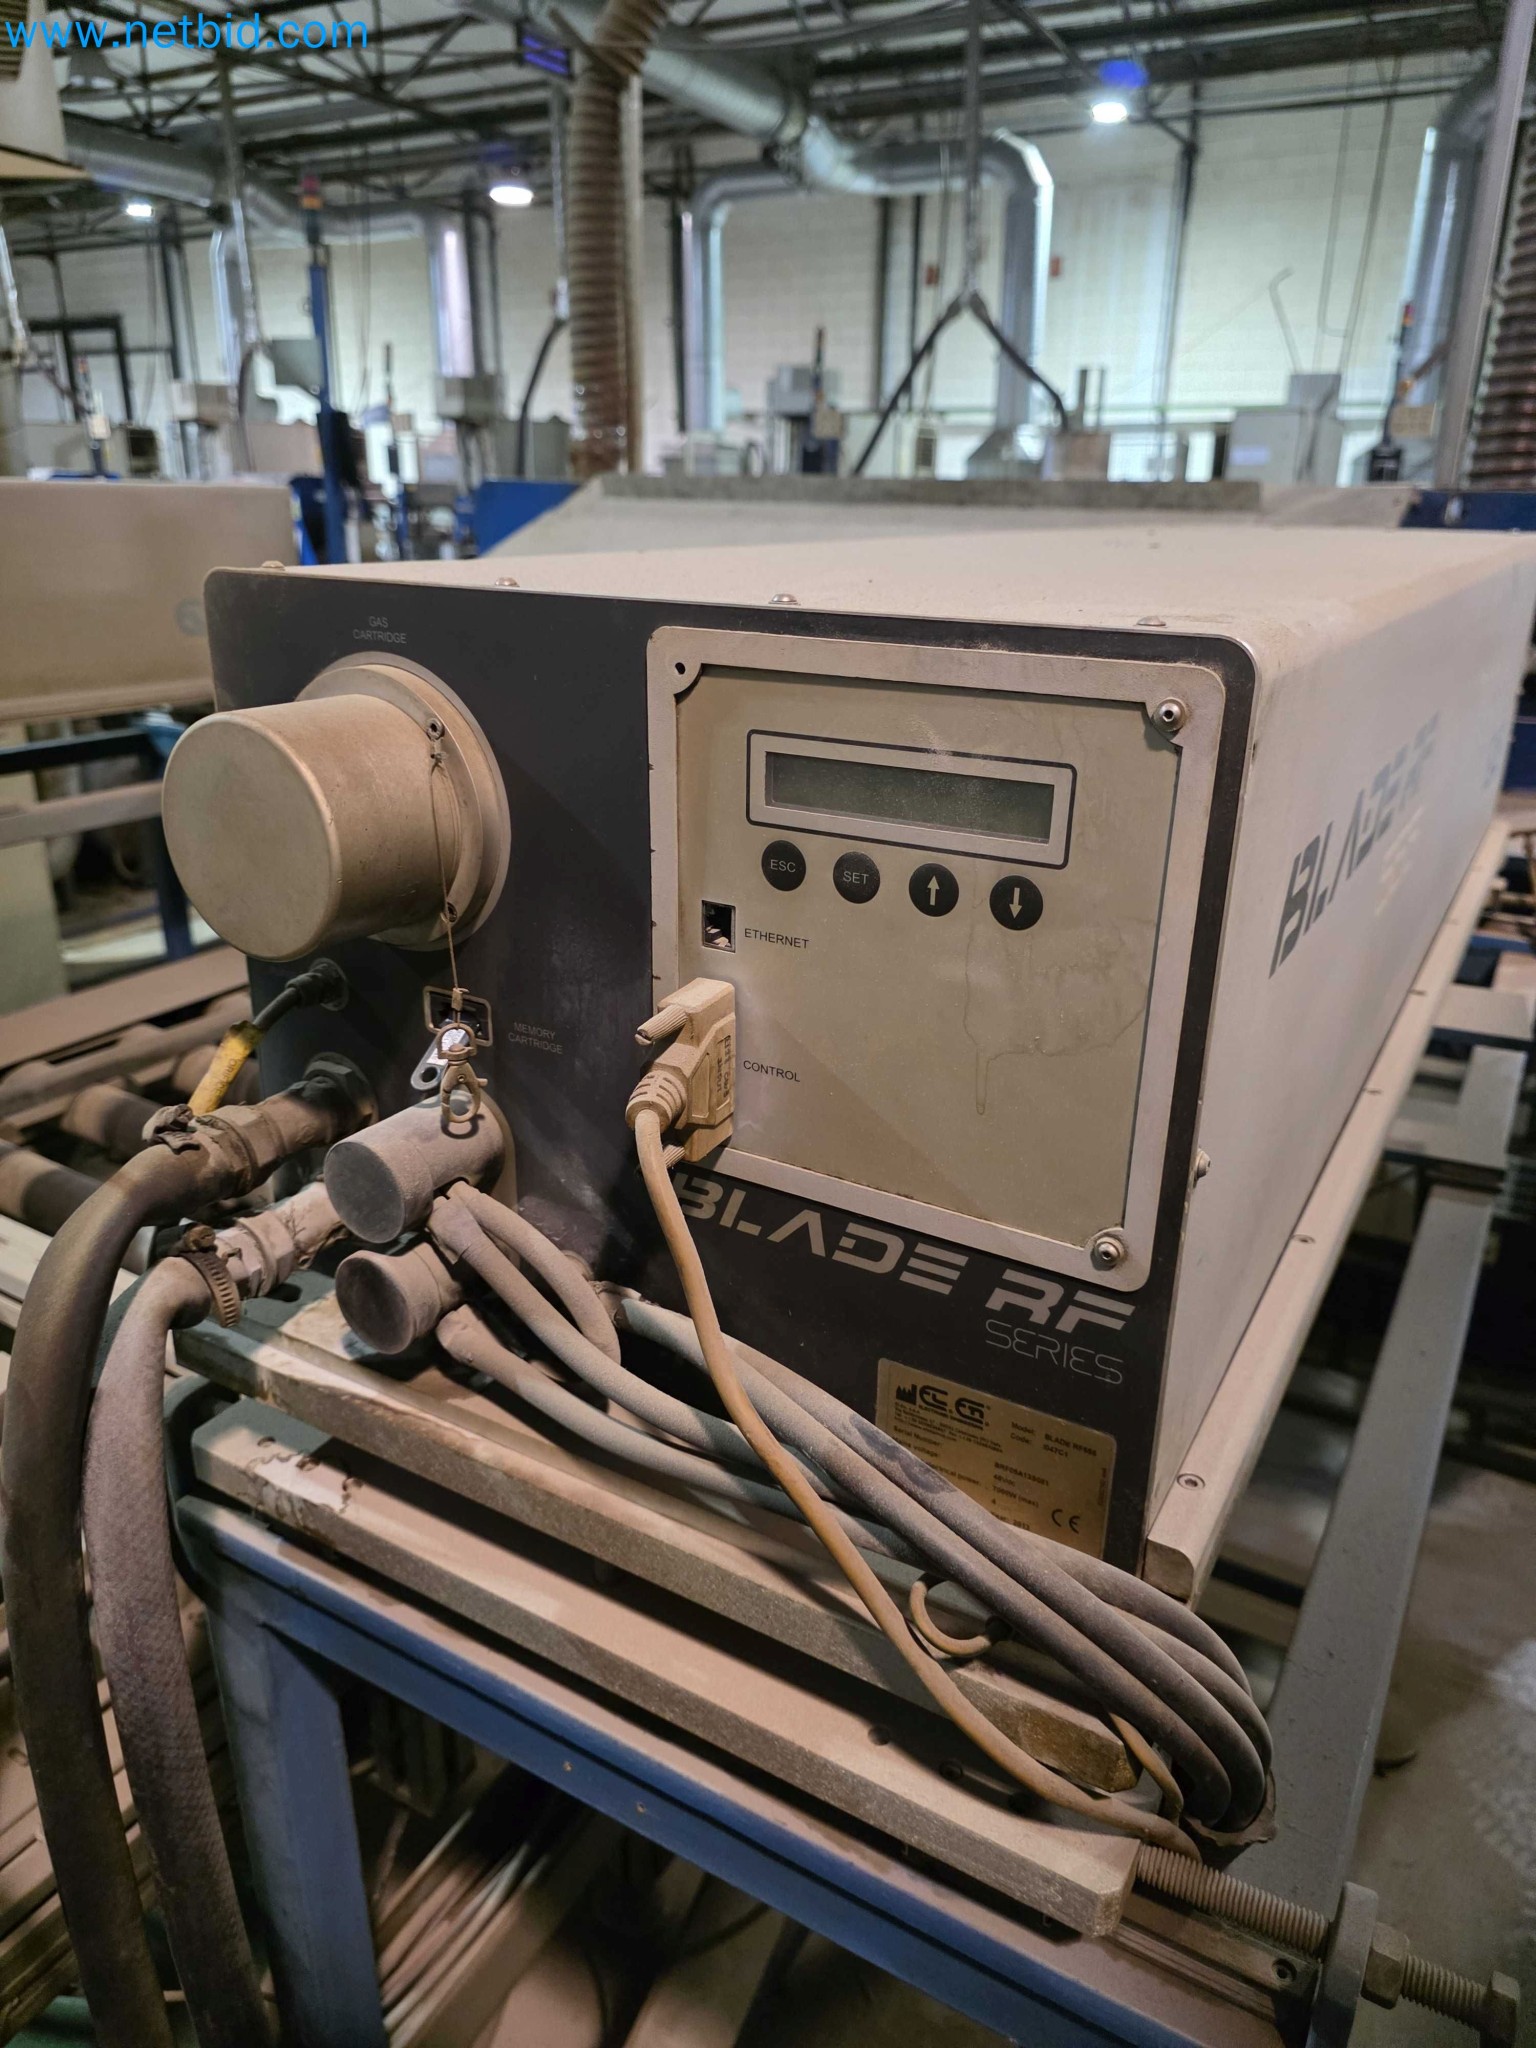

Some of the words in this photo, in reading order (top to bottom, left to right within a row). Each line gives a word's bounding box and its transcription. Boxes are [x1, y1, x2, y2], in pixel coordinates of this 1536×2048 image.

[368, 615, 389, 629] GAS
[352, 628, 408, 645] CARTRIDGE
[769, 858, 797, 874] ESC
[842, 869, 869, 885] SET
[744, 927, 810, 950] ETHERNET
[513, 1021, 557, 1040] MEMORY
[507, 1031, 564, 1055] CARTRIDGE
[743, 1059, 801, 1083] CONTROL
[674, 1172, 969, 1296] BLADE
[985, 1268, 1136, 1334] RF
[985, 1319, 1124, 1385] SERIES
